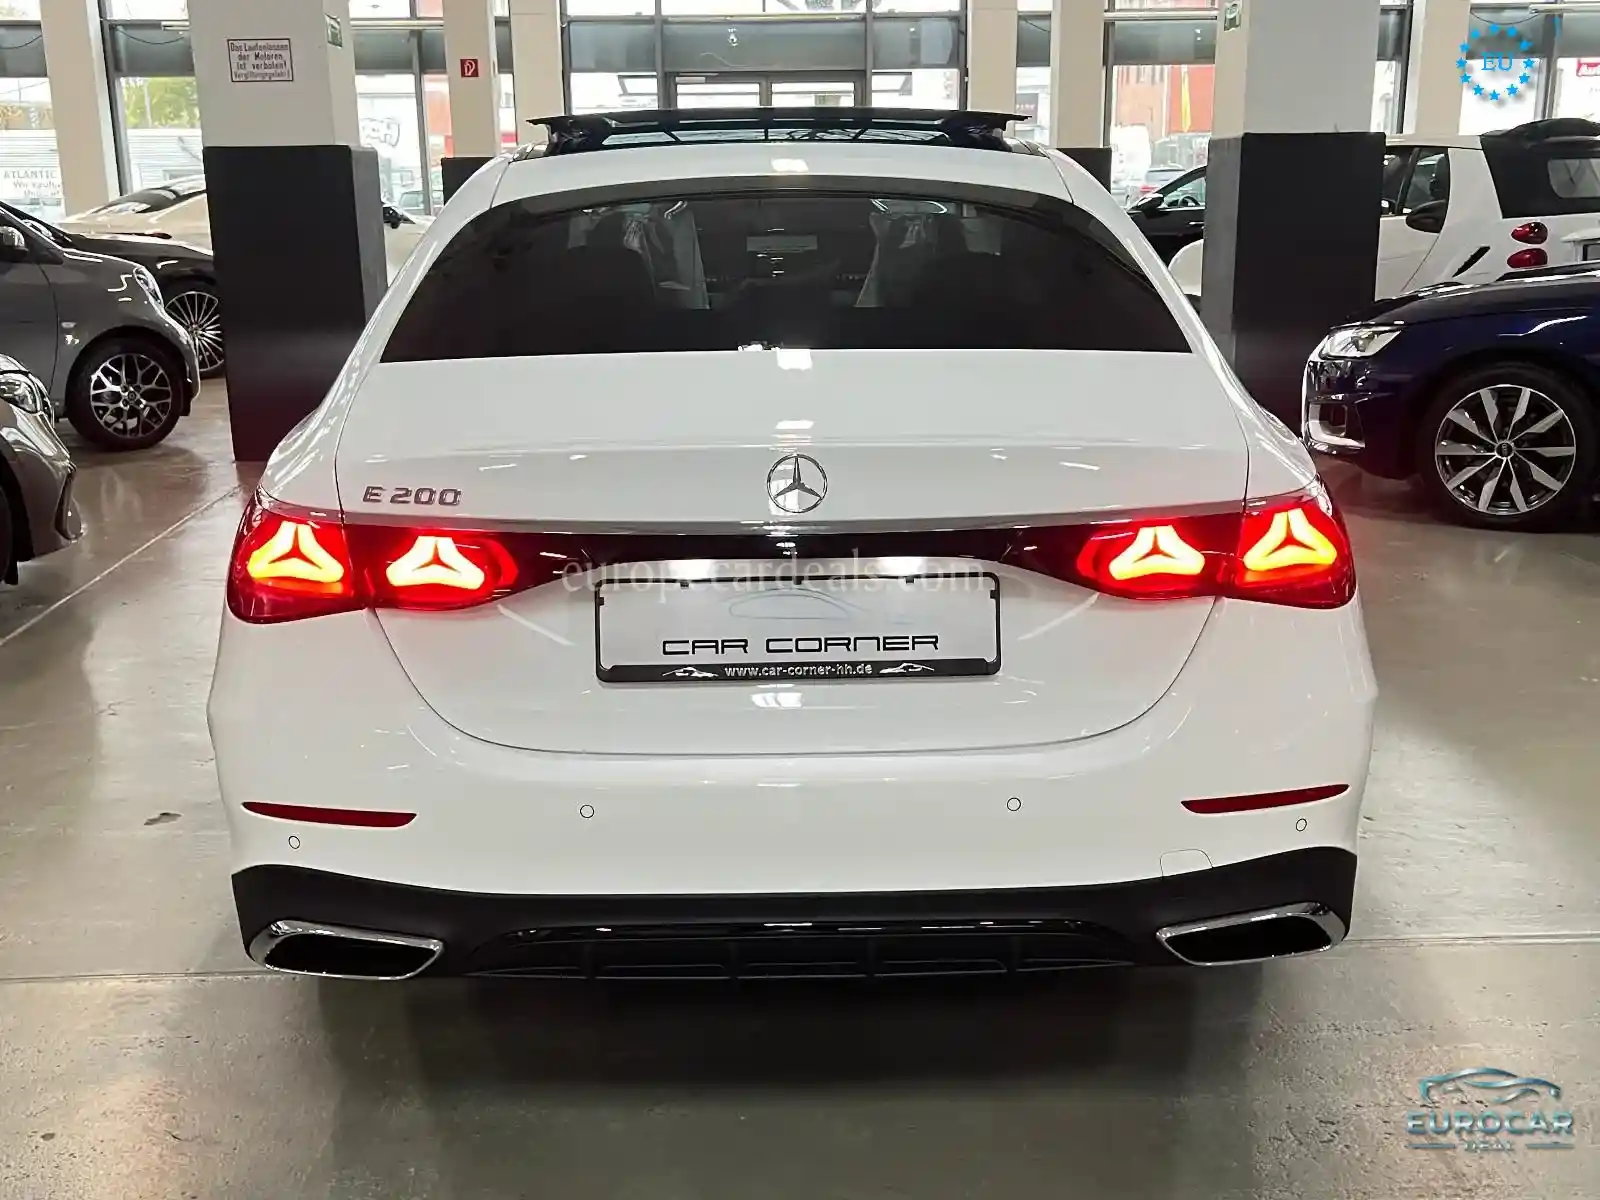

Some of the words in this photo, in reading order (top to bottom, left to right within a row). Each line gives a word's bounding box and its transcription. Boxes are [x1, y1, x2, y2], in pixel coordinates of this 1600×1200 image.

[254, 51, 283, 61] Motoren
[363, 486, 386, 503] E
[390, 487, 462, 506] 200
[662, 638, 749, 656] CAR
[765, 635, 939, 653] CORNER
[724, 663, 873, 678] www.car-corner-hh.de
